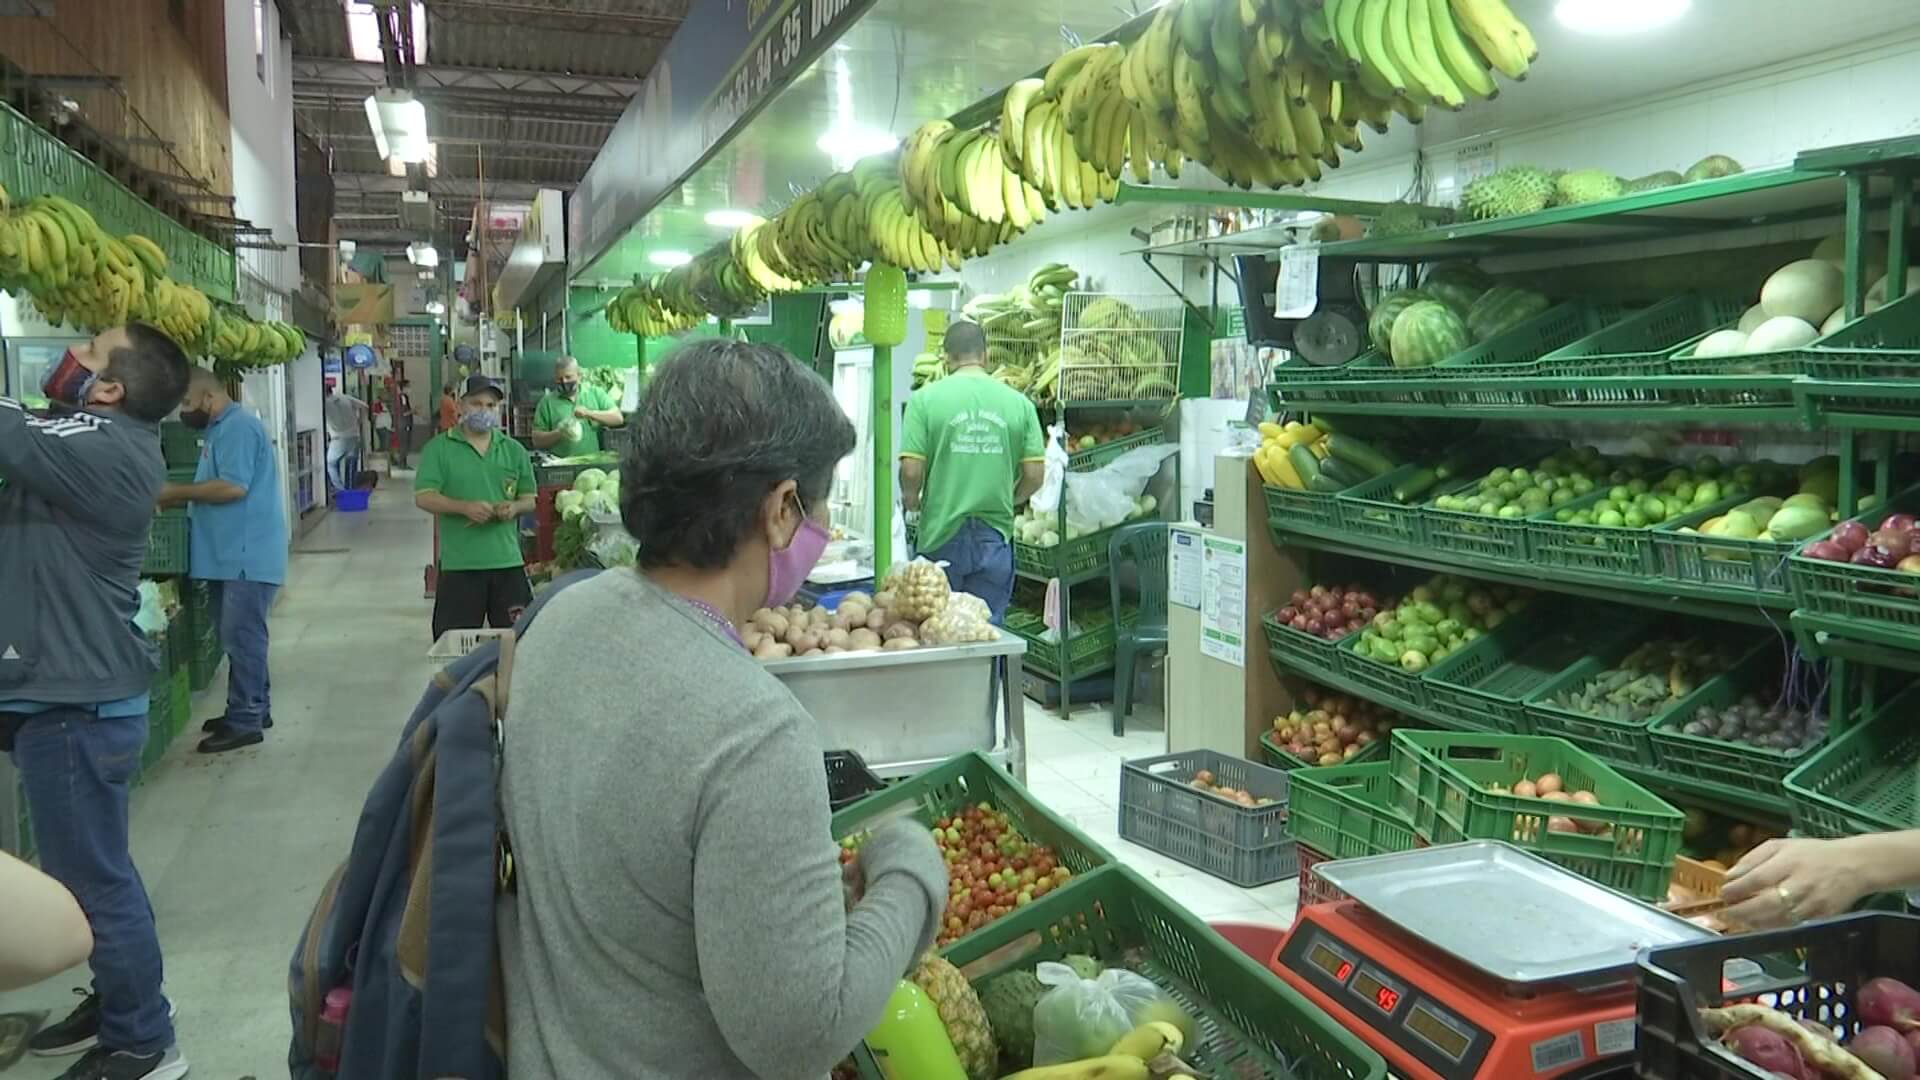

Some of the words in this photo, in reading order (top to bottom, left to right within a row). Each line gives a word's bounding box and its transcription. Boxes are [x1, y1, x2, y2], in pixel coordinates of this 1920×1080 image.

[756, 37, 772, 93] 34
[781, 5, 802, 67] 35
[1336, 964, 1352, 981] 0
[1377, 987, 1398, 1011] 45
